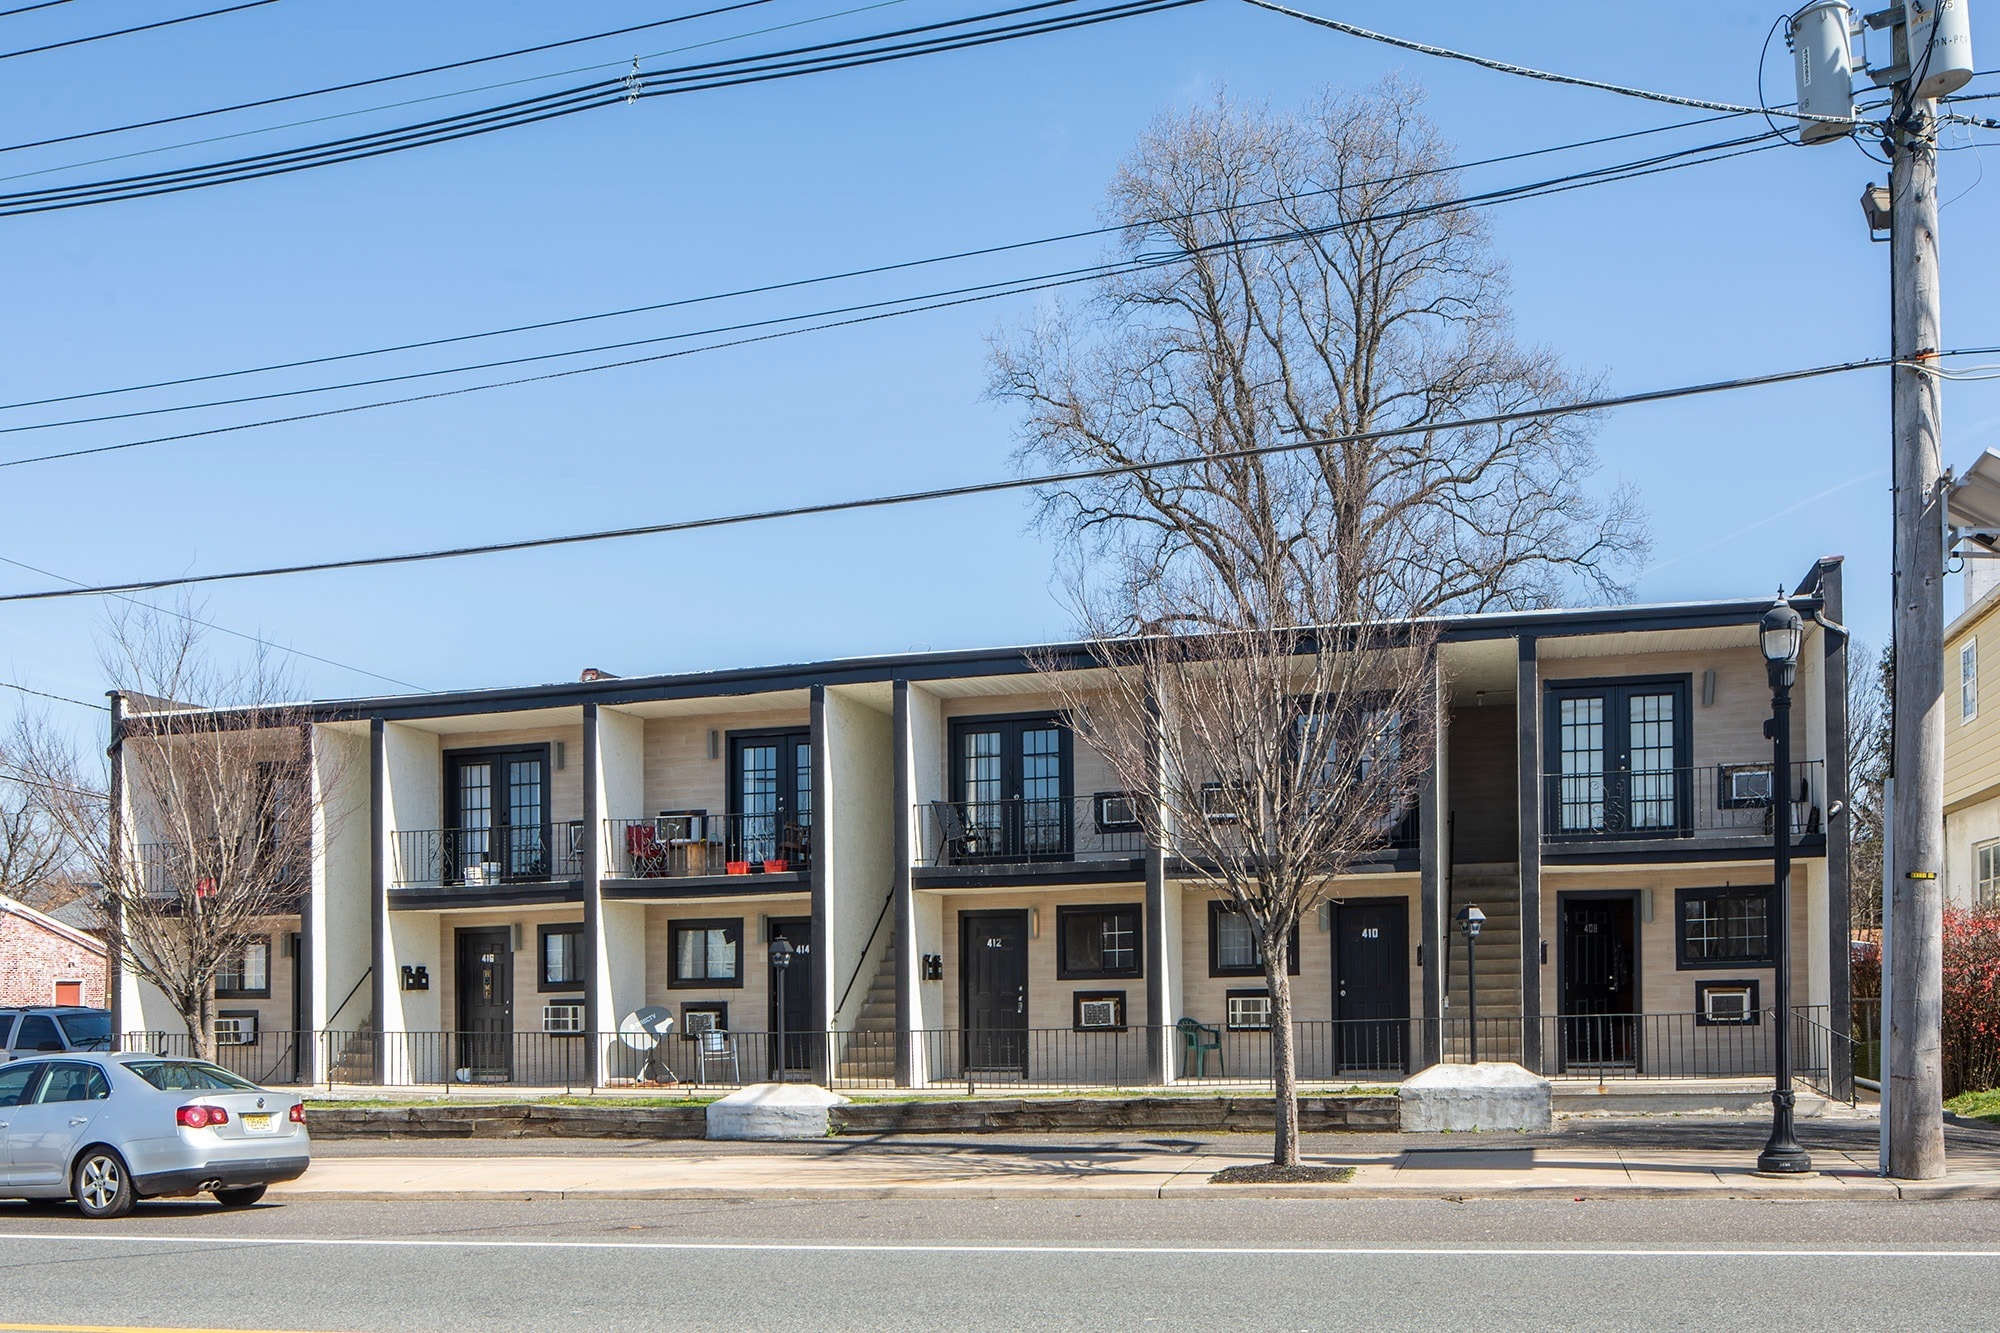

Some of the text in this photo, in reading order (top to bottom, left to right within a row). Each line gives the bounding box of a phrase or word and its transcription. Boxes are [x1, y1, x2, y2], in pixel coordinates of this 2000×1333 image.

[1361, 928, 1378, 938] 410
[1583, 924, 1598, 933] 408
[986, 938, 1002, 948] 412
[795, 944, 810, 954] 414
[481, 953, 495, 963] 416
